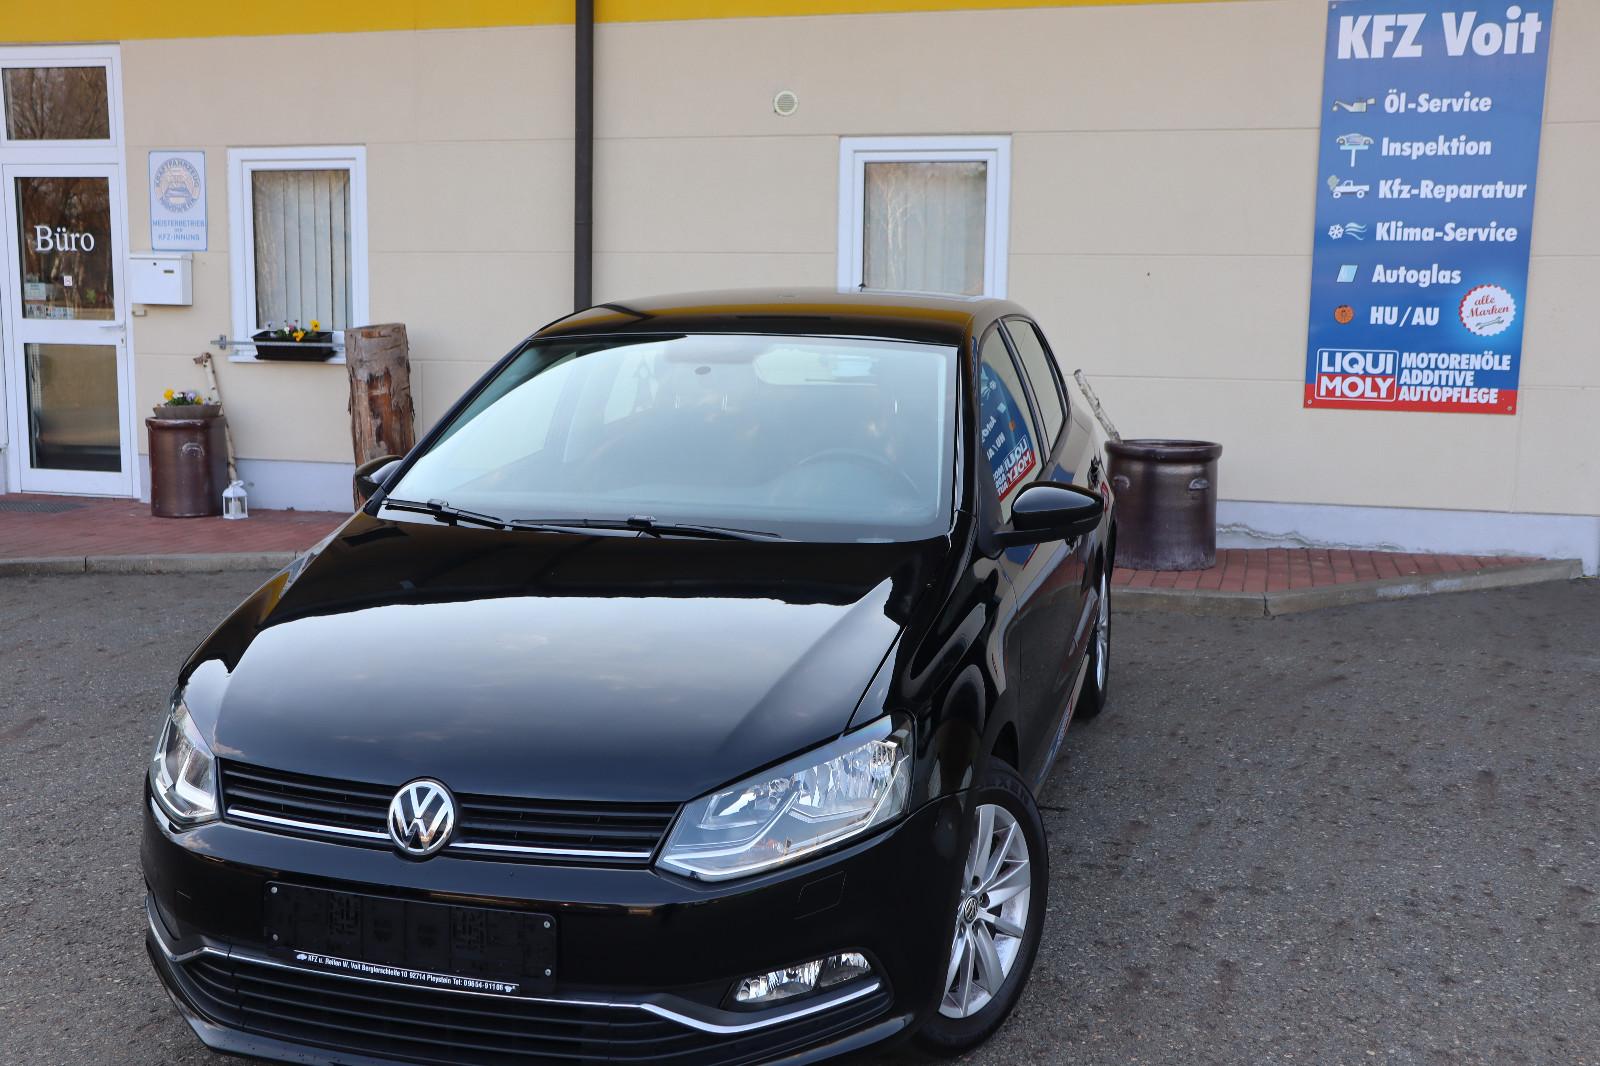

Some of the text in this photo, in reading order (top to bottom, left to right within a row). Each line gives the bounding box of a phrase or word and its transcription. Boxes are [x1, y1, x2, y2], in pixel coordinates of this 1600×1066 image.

[1337, 5, 1542, 59] KFZ Voit
[1384, 89, 1492, 113] Öl-Service
[1381, 134, 1492, 160] Inspektion
[1378, 178, 1527, 202] Kfz-Reparatur
[34, 224, 95, 252] Büro
[1375, 220, 1518, 242] Klima-Service
[1371, 263, 1462, 288] Autoglas
[1474, 294, 1496, 306] alle
[1466, 304, 1510, 319] Marken
[1321, 352, 1393, 375] LIQUI
[1401, 351, 1511, 371] MOTORENÖLE
[1319, 376, 1394, 398] MOLY
[1400, 370, 1475, 386] ADDITIVE
[1398, 386, 1499, 404] AUTOPFLEGE
[308, 954, 318, 963] KFZ
